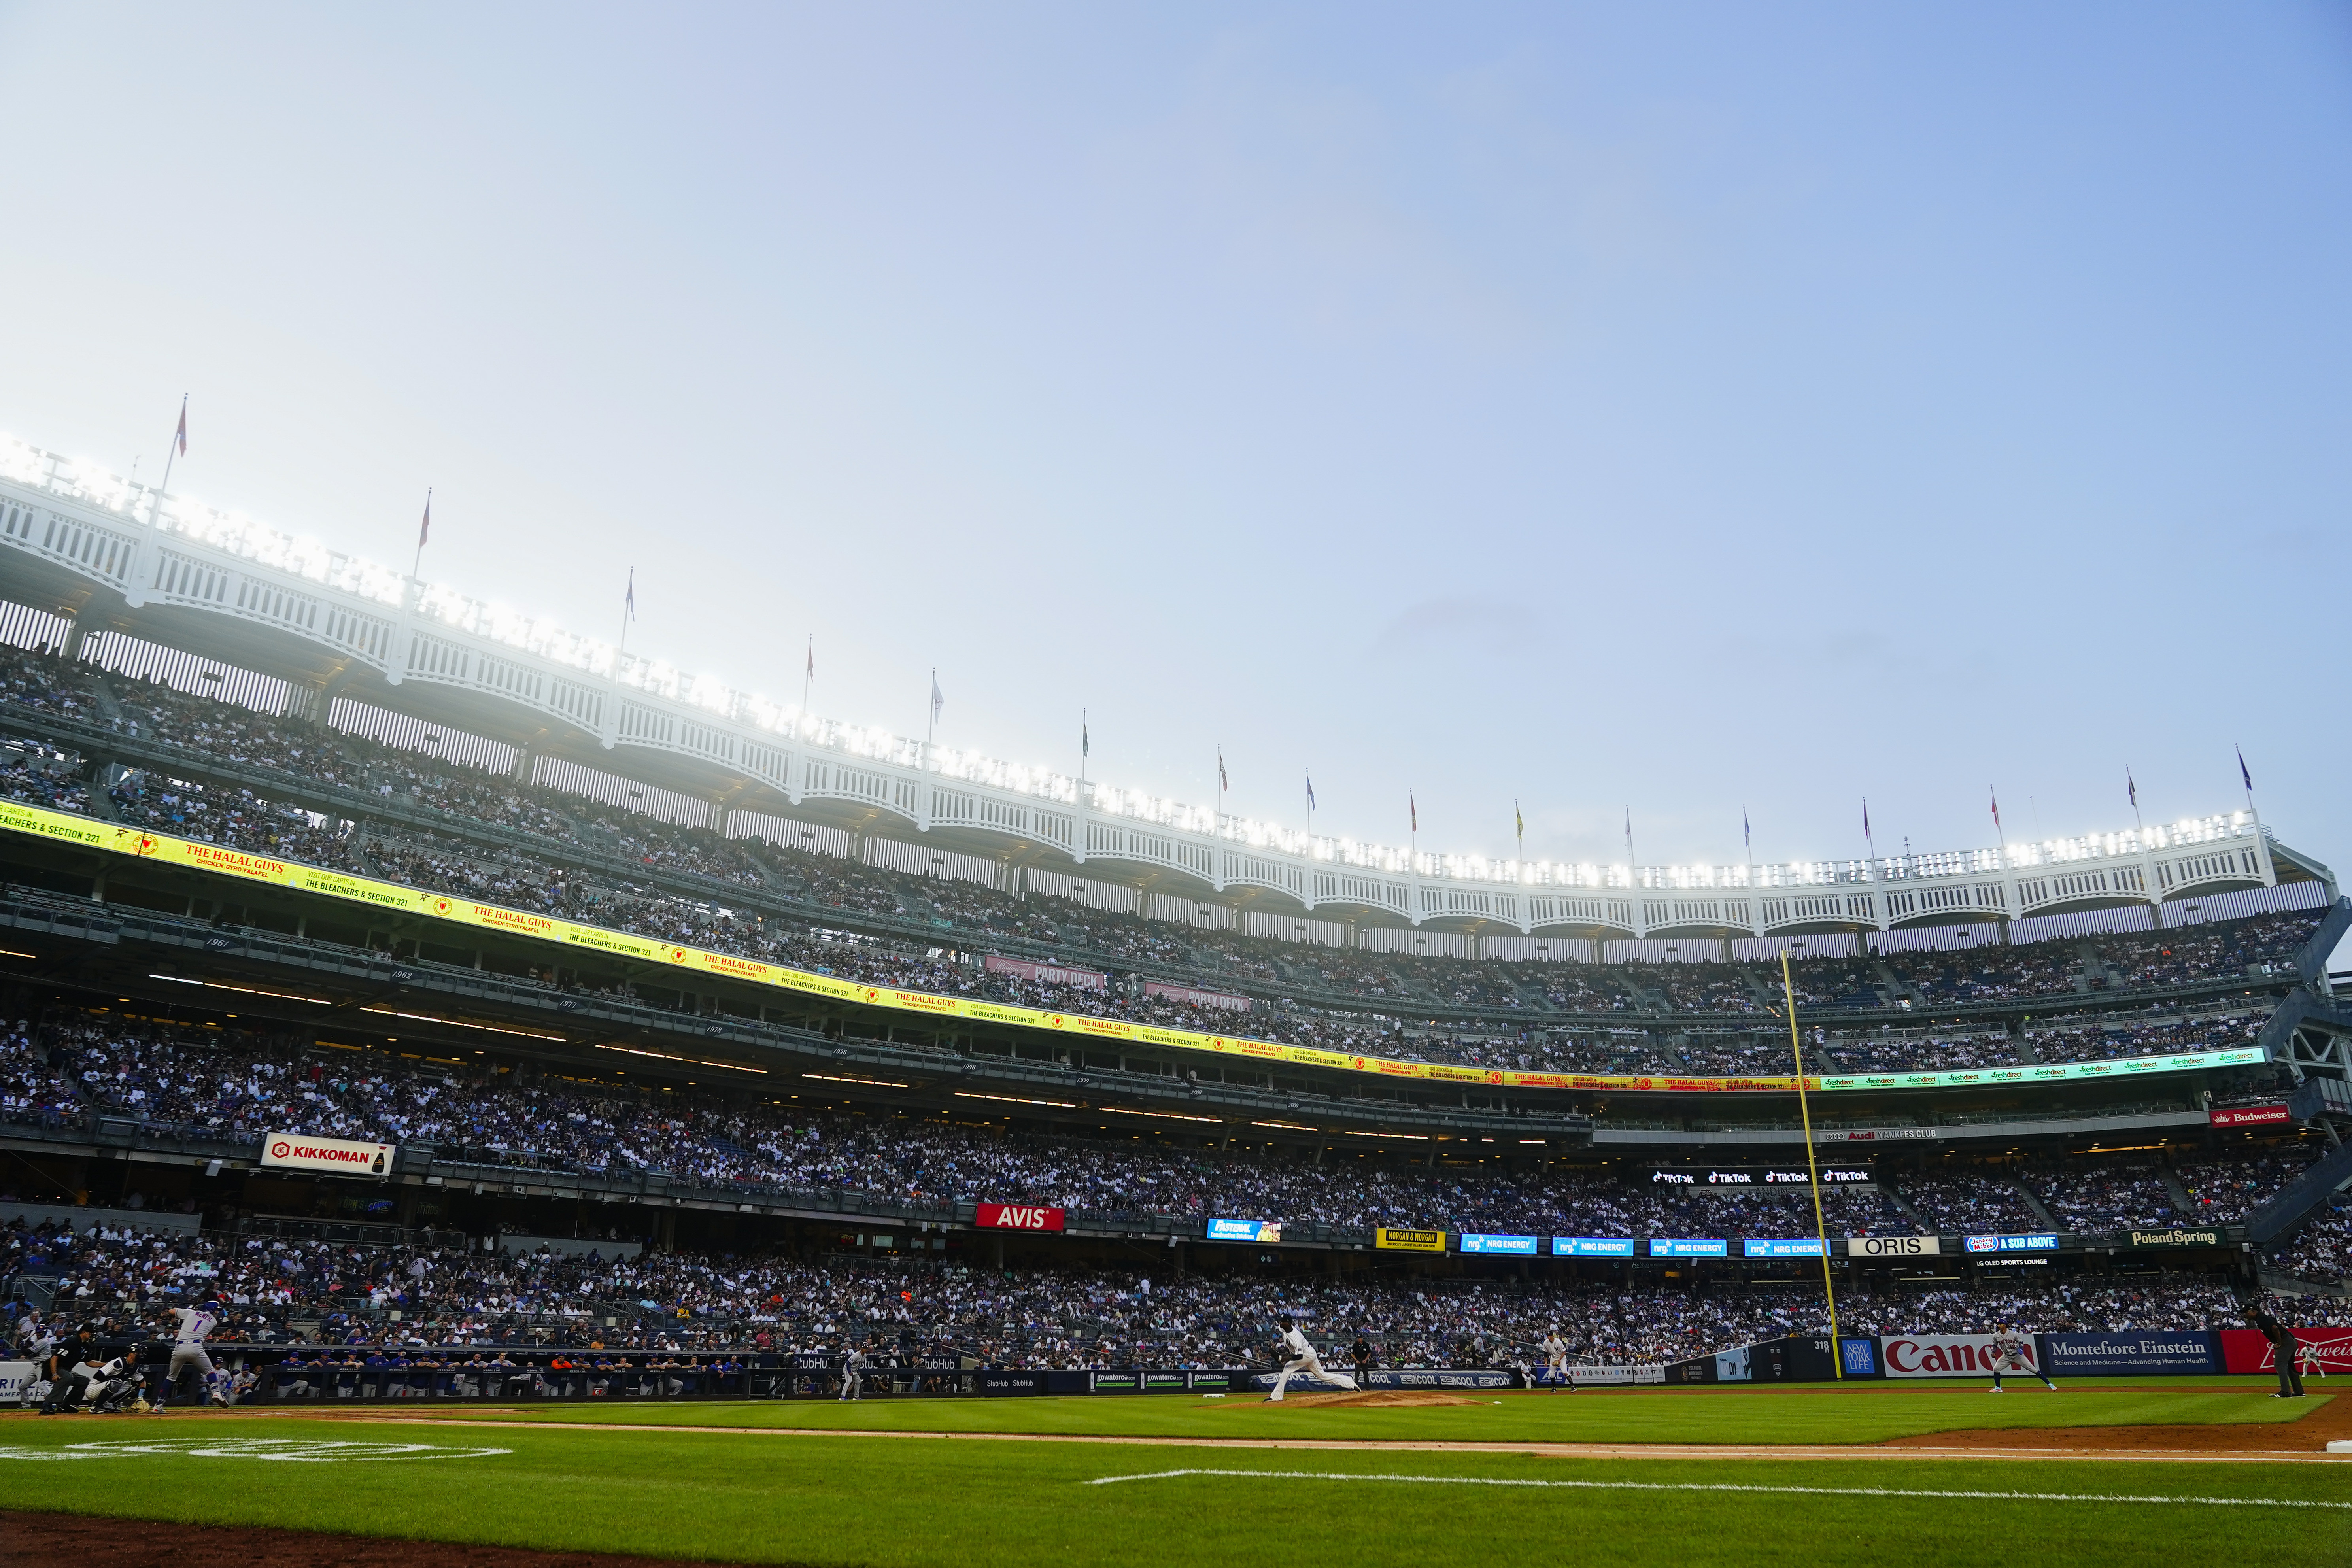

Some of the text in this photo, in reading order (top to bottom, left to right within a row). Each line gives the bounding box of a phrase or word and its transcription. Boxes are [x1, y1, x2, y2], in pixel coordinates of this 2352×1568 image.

[48, 826, 83, 839] SECTION
[85, 833, 100, 843] 321
[186, 845, 284, 873] THE HALAL GUYS
[196, 859, 223, 868] CHICKEN
[244, 868, 268, 878] FALAFEL
[308, 871, 321, 879] VISIT
[333, 877, 349, 885] CARTS
[306, 879, 319, 888] THE
[320, 882, 359, 896] BLEACHERS
[368, 892, 395, 904] SECTION
[397, 898, 408, 907] 321
[474, 906, 552, 929] THE HALAL GUYS
[483, 918, 504, 926] CHICKEN
[207, 938, 229, 947] 1961
[581, 936, 611, 948] BLEACHERS
[618, 944, 640, 954] SECTION
[704, 954, 767, 974] THE HALAL GUYS
[997, 962, 1027, 974] Budweiser
[1035, 966, 1098, 987] PARTY DECK
[791, 979, 816, 990] BLEACHERS
[822, 986, 840, 995] SECTION
[1188, 991, 1245, 1011] PARTY DECK
[2233, 1111, 2287, 1122] Budweiser
[1848, 1132, 1875, 1140] Audi
[1878, 1130, 1914, 1139] YANKEES
[293, 1146, 370, 1163] KIKKOMAN
[1719, 1174, 1751, 1183] TikTok
[1776, 1172, 1809, 1182] TikTok
[1834, 1171, 1869, 1181] TikTok
[997, 1207, 1045, 1228] AVIS
[1215, 1220, 1251, 1233] FASTENAL
[1389, 1231, 1435, 1242] MORGAN & MORGAN
[2131, 1230, 2216, 1246] Poland Spring
[1503, 1240, 1530, 1249] ENERGY
[1598, 1243, 1626, 1252] ENERGY
[1865, 1238, 1921, 1254] ORIS
[2001, 1237, 2055, 1249] A SUB ABOVE
[195, 1311, 213, 1322] McNEIL
[193, 1320, 203, 1332] 1
[1814, 1341, 1829, 1349] 318
[1847, 1344, 1867, 1353] NEW
[2051, 1339, 2207, 1355] Montefiore Einstein
[57, 1348, 69, 1356] 72
[1845, 1352, 1871, 1362] YORK
[1849, 1361, 1869, 1370] LIFE
[1417, 1375, 1437, 1385] COOL
[1542, 1370, 1563, 1379] AC
[1456, 1376, 1477, 1386] COOL
